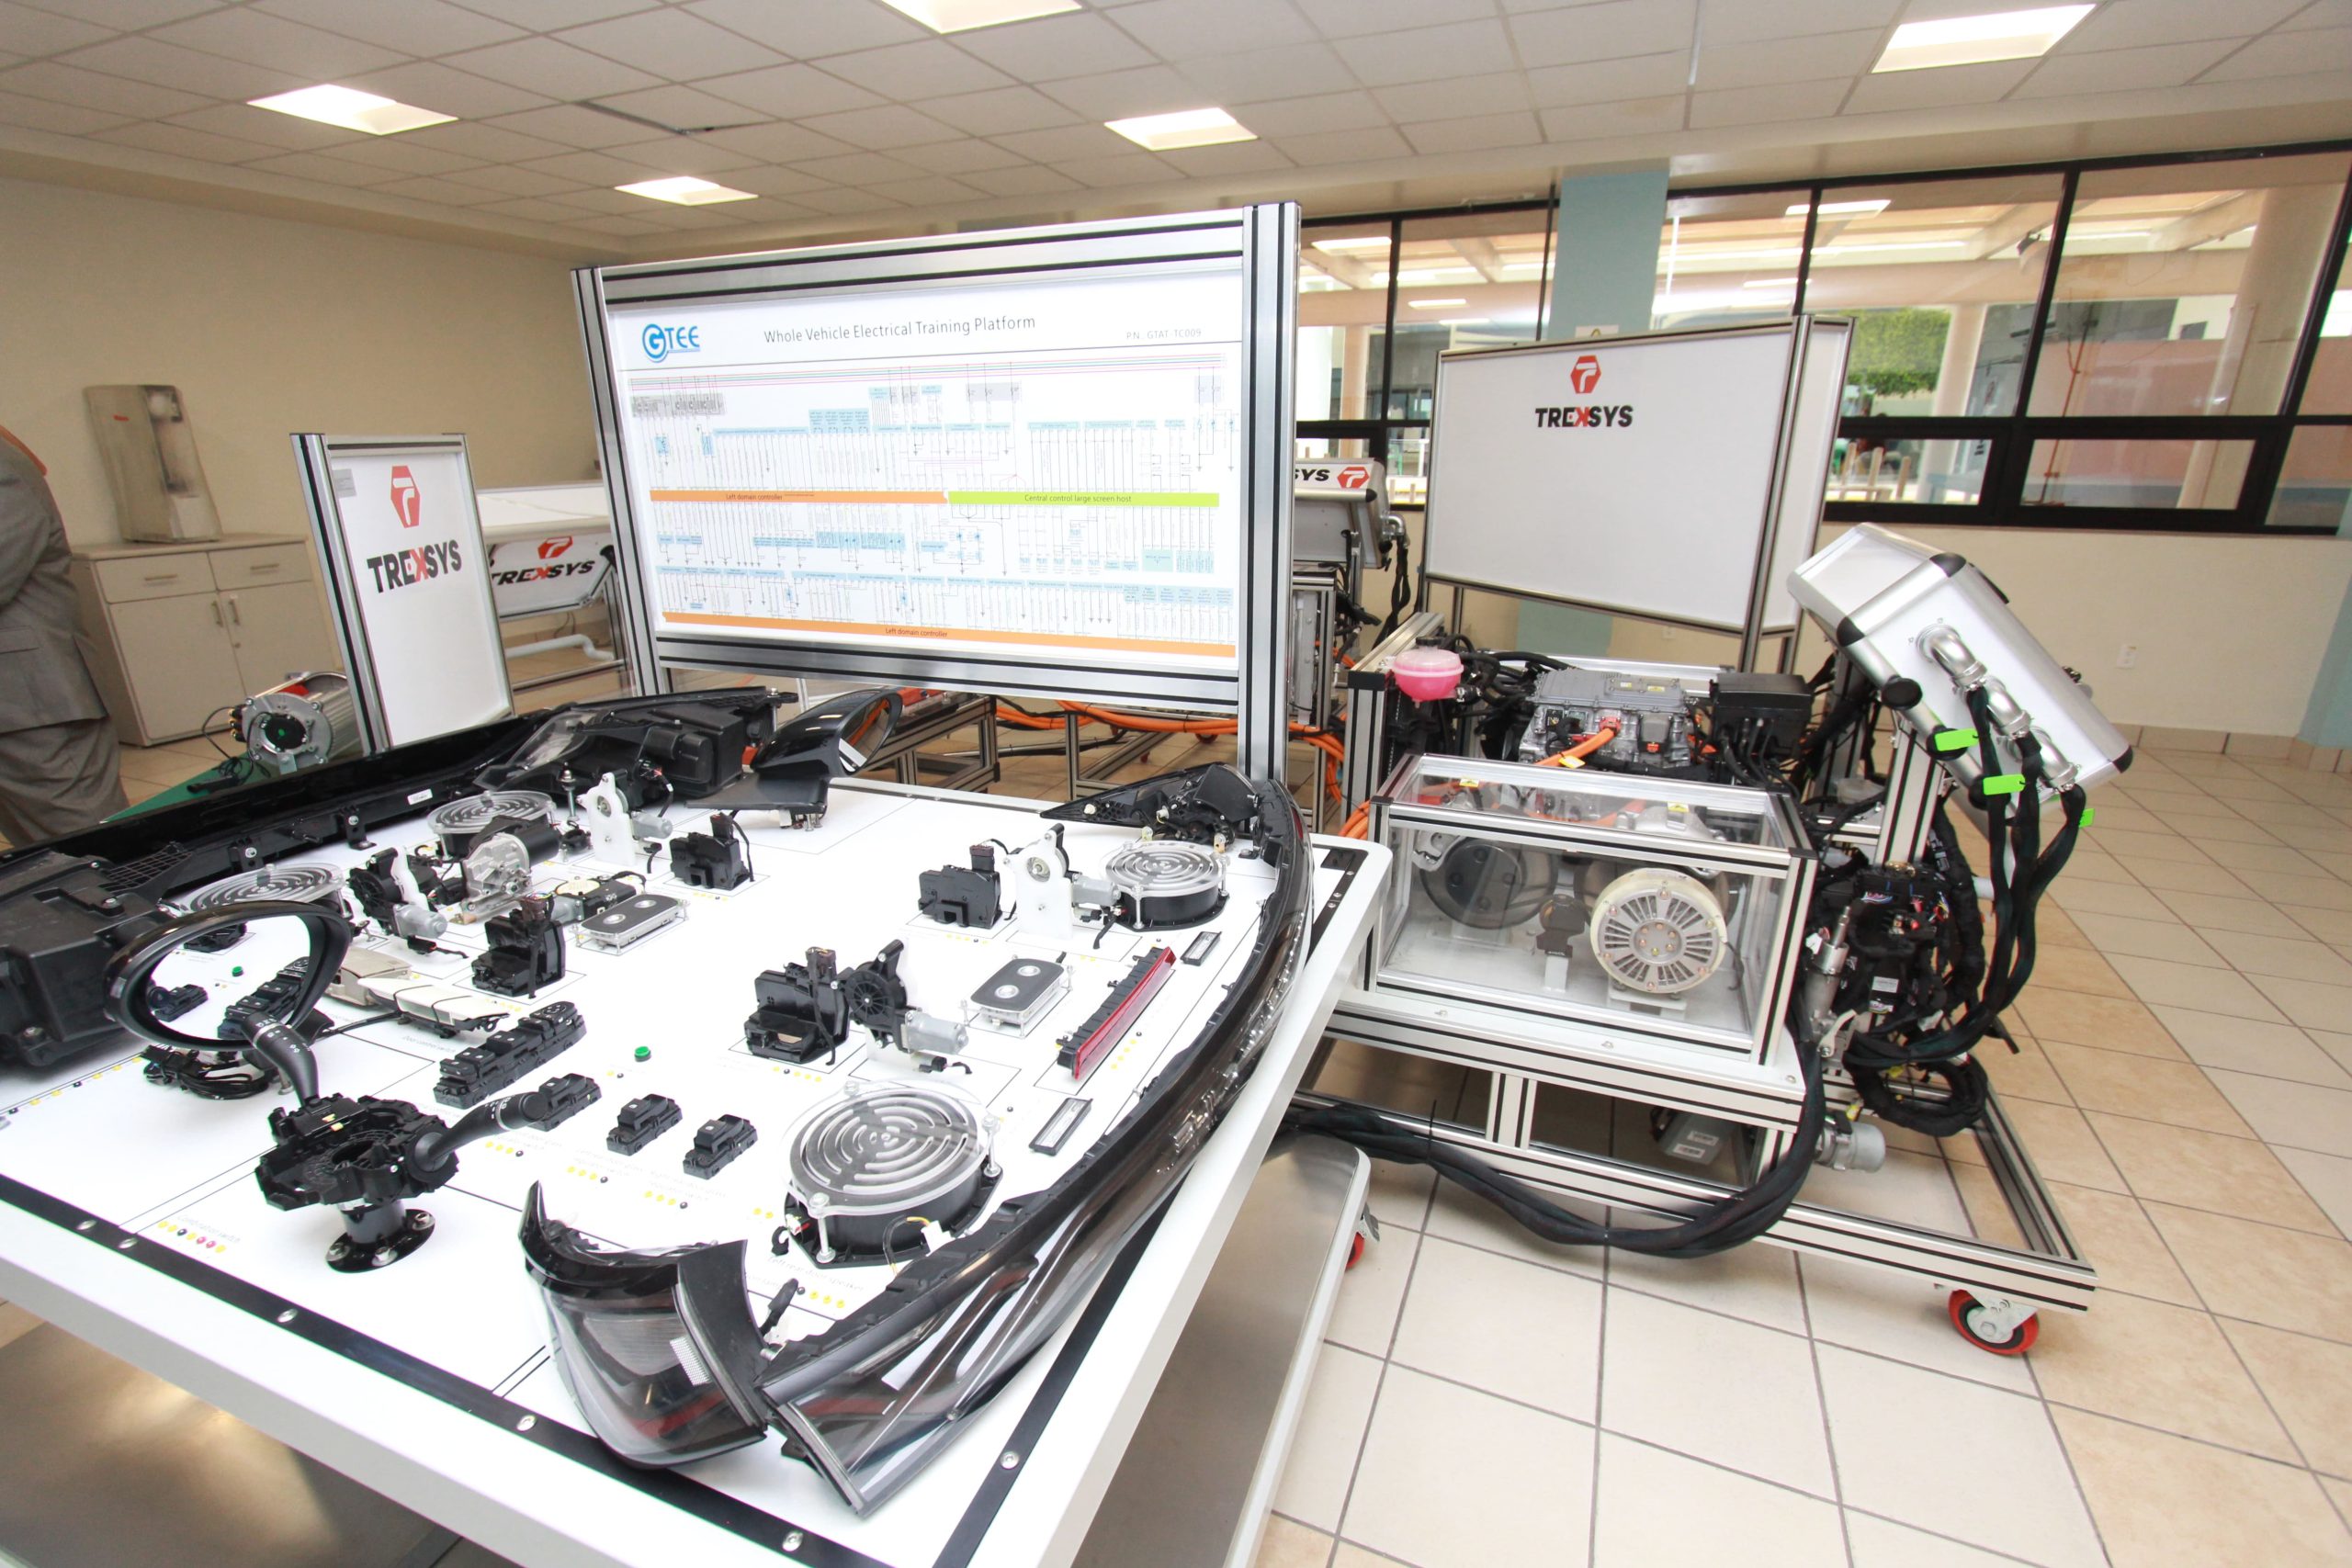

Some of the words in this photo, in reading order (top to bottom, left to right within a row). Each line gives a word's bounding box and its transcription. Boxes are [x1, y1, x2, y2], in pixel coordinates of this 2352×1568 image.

[763, 329, 802, 344] Whole
[805, 326, 850, 341] Vehicle
[854, 321, 911, 338] Electrical
[915, 319, 970, 336] Training
[975, 315, 1035, 332] Platform
[726, 492, 736, 501] Left
[737, 492, 757, 501] domain
[758, 492, 783, 501] controller
[1074, 495, 1091, 504] large
